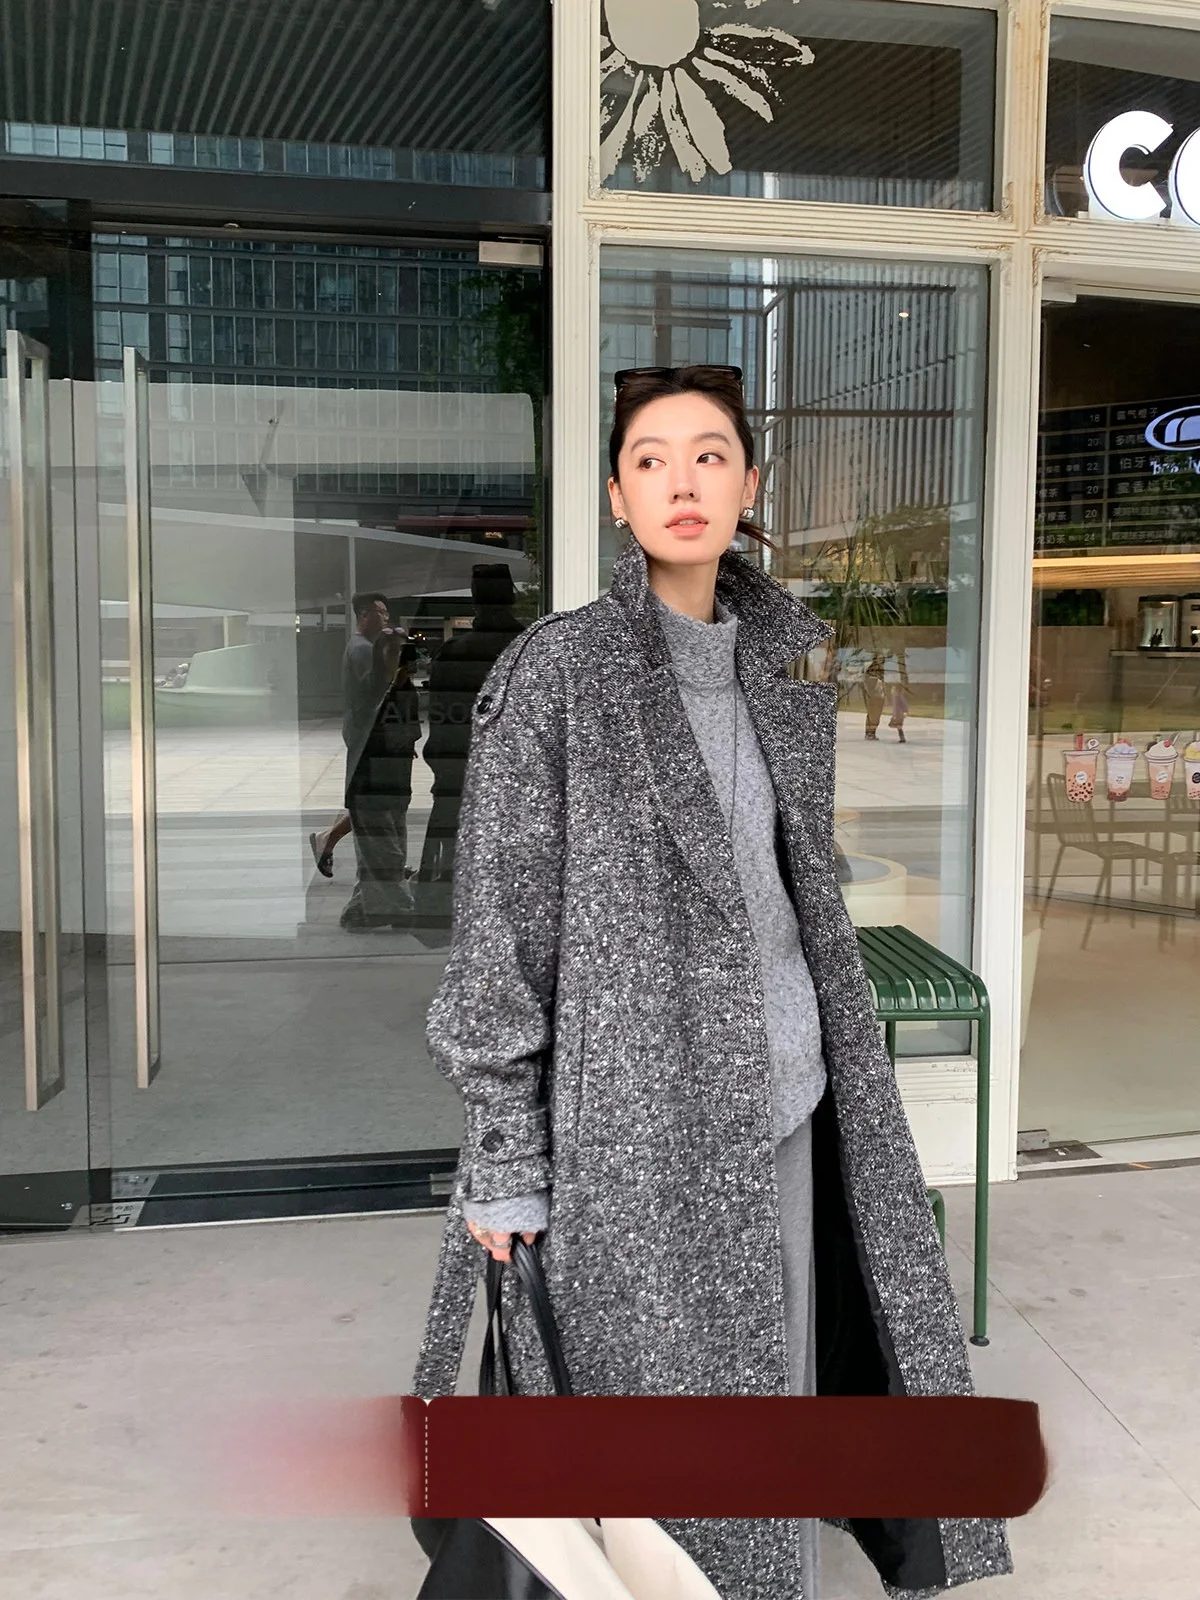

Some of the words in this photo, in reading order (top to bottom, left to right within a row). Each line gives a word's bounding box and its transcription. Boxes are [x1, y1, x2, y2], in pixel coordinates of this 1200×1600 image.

[1089, 413, 1101, 423] 18
[1087, 437, 1100, 447] 20
[1086, 462, 1099, 471] 22
[1086, 485, 1099, 495] 20
[1085, 509, 1098, 519] 20
[1084, 533, 1095, 542] 24
